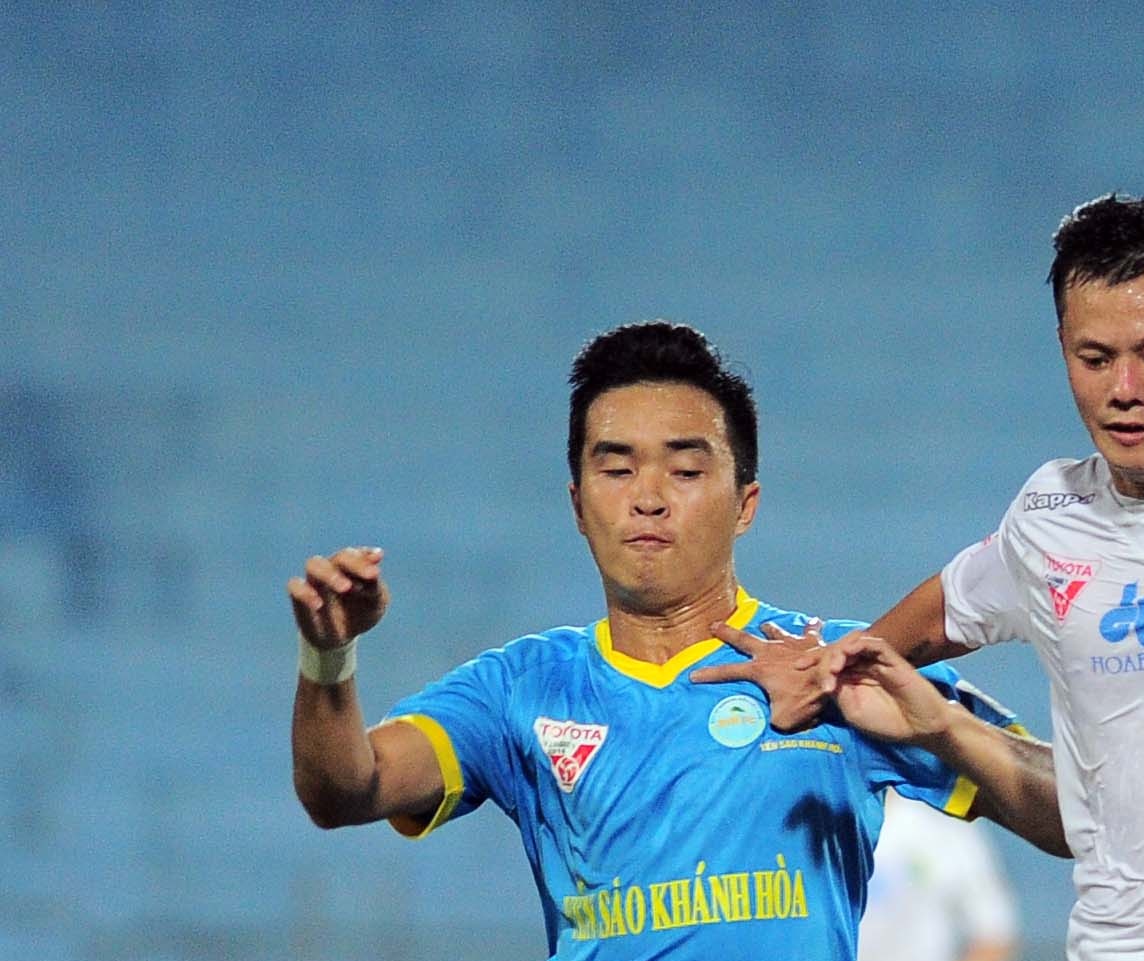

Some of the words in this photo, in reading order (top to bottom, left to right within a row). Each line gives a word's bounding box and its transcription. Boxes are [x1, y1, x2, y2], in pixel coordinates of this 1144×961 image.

[542, 724, 602, 740] TOYOTA
[649, 860, 752, 931] KHÁNH
[752, 853, 809, 920] HÒA
